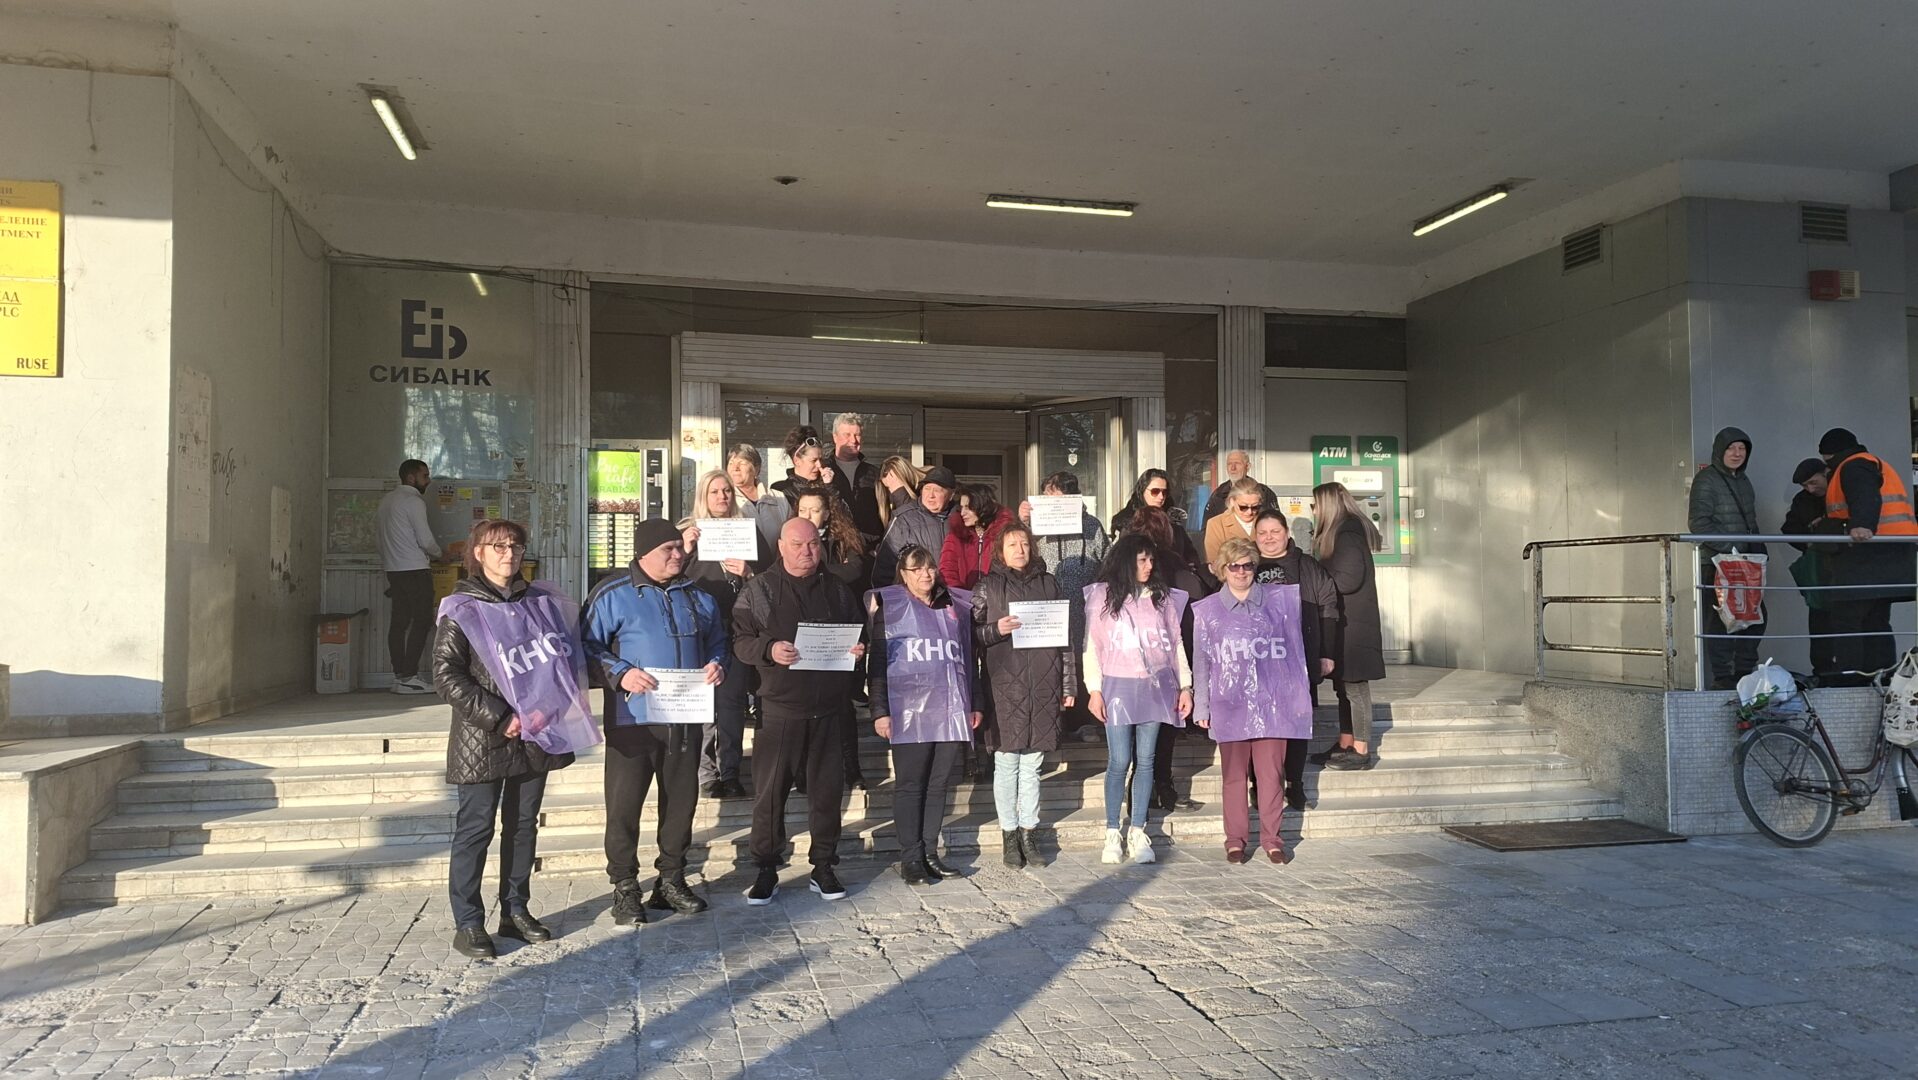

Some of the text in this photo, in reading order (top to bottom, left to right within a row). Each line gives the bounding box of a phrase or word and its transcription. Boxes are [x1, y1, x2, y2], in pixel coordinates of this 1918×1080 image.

[0, 290, 20, 303] АД
[16, 357, 49, 370] RUSE
[368, 364, 492, 387] СИБАНК
[1319, 446, 1348, 458] ATM
[1214, 637, 1287, 664] КНСБ
